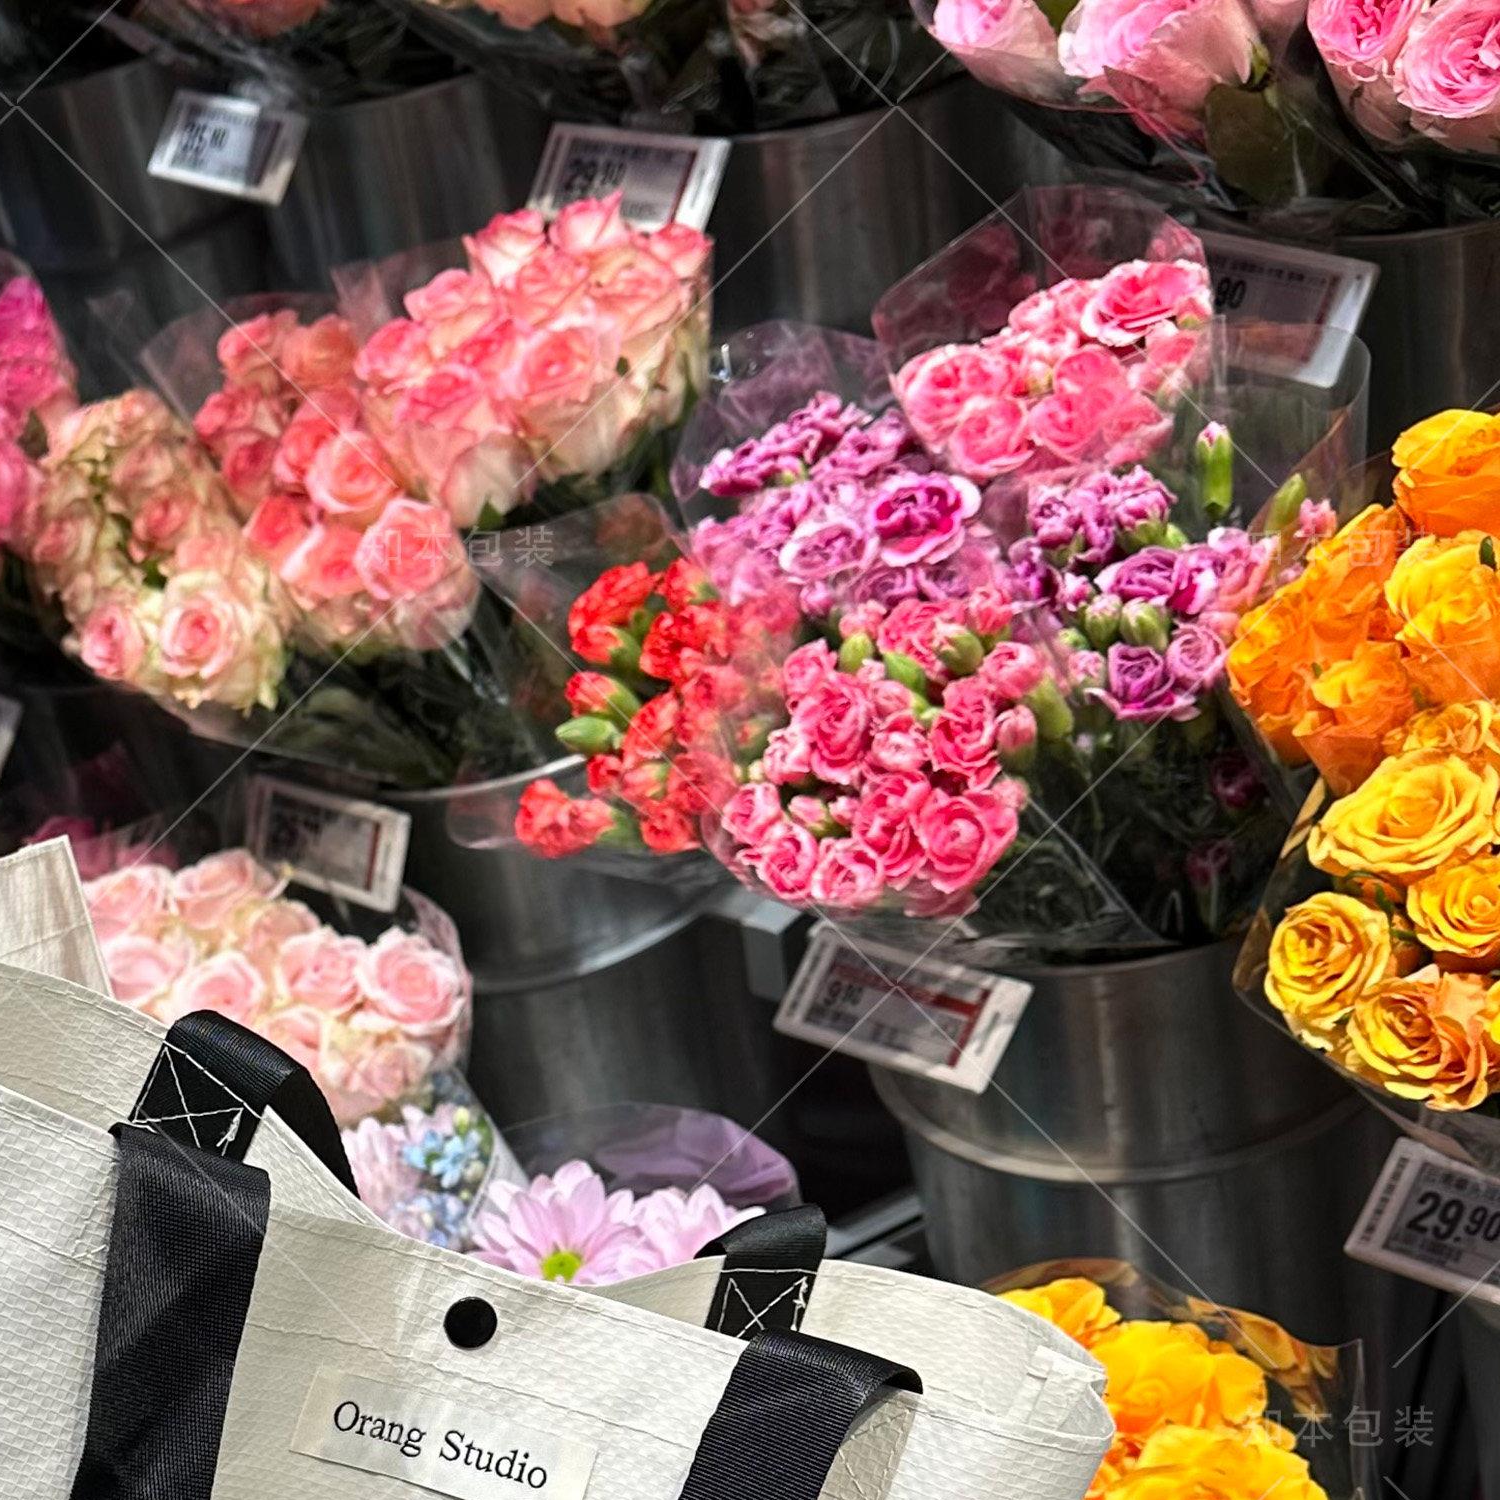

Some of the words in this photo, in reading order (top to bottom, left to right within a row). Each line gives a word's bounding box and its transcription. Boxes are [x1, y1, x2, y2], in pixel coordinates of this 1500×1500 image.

[1405, 1191, 1500, 1242] 29.90
[333, 1400, 427, 1458] Orang
[439, 1429, 548, 1490] Studio
